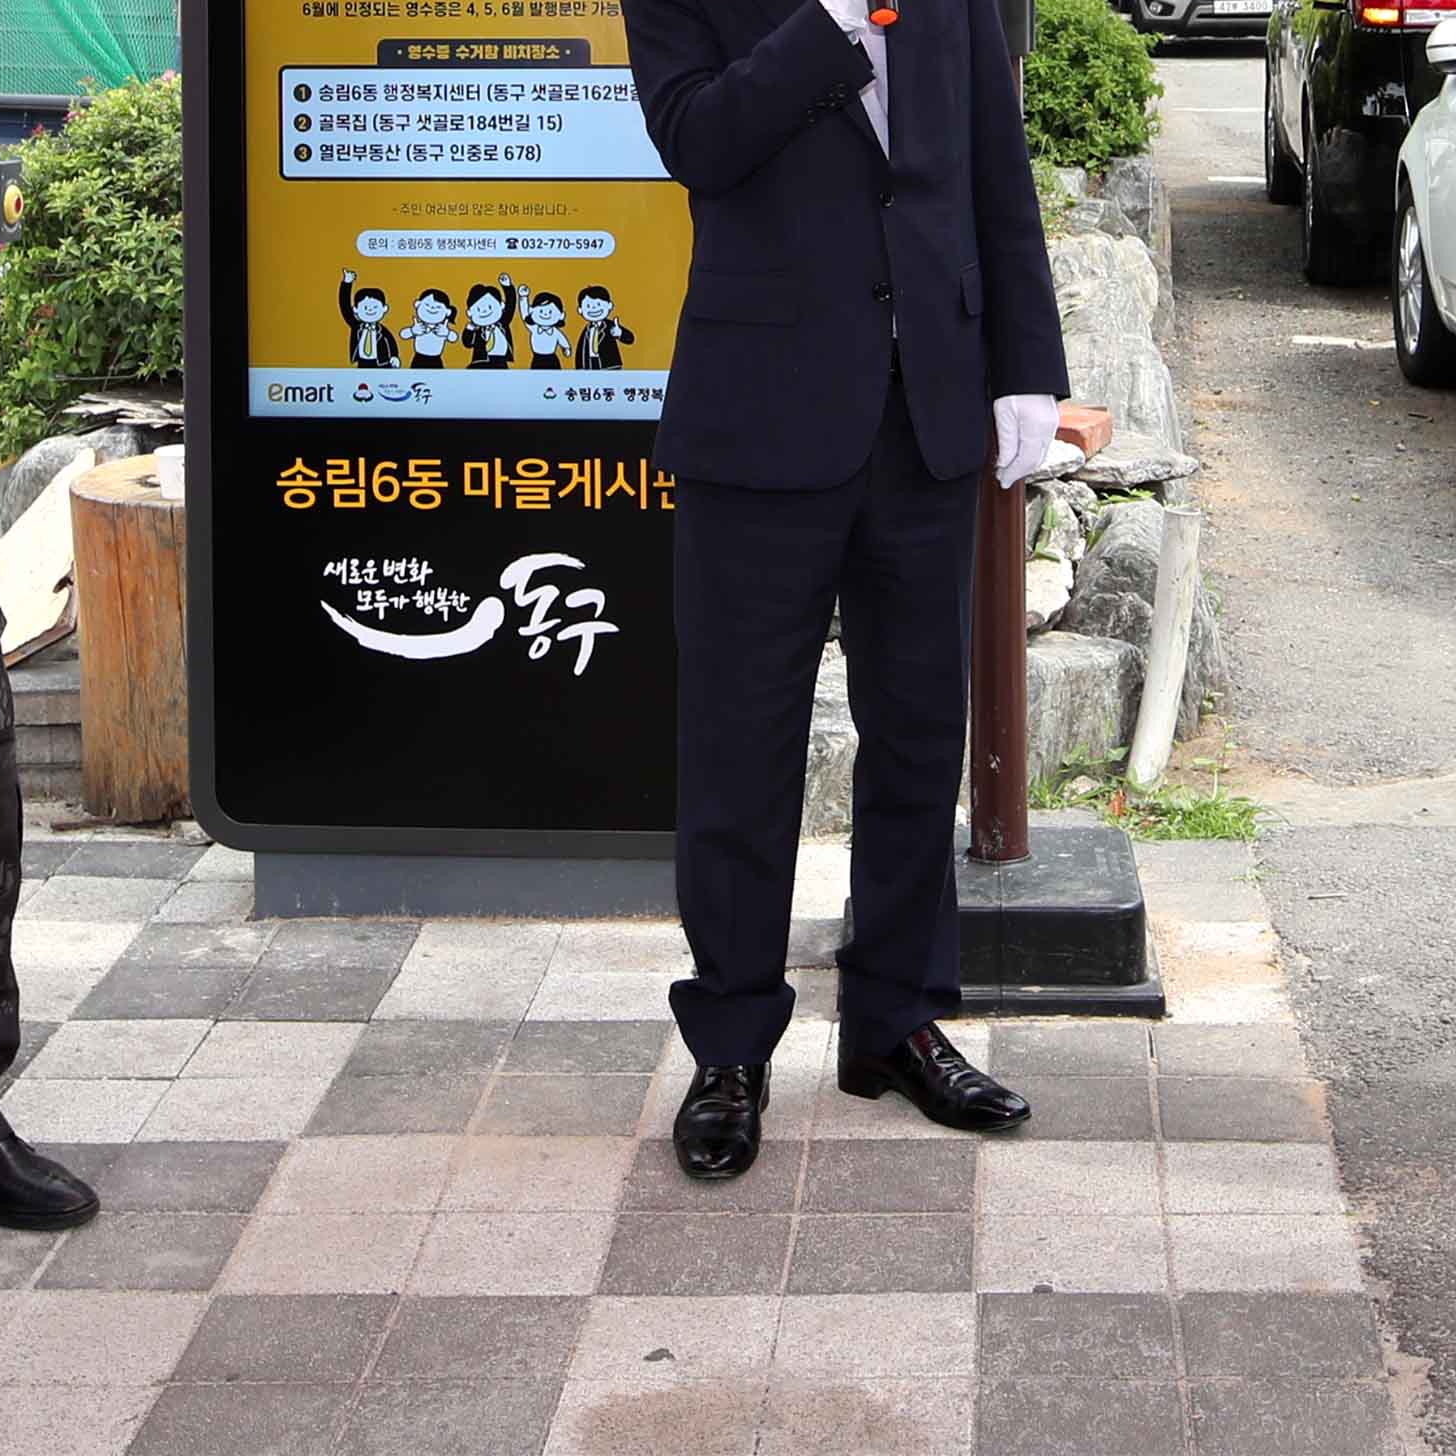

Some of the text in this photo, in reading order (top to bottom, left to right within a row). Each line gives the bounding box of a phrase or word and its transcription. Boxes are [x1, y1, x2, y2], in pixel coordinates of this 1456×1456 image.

[302, 1, 339, 18] 6월에
[344, 1, 401, 18] 인정되는
[405, 1, 461, 18] 영수증은
[466, 2, 481, 19] 4,
[484, 2, 498, 19] 5,
[501, 1, 525, 18] 6월
[529, 1, 586, 18] 발행분만
[407, 44, 561, 60] 영수증 수거함 비치장소
[318, 82, 379, 103] 송림6동
[382, 82, 481, 103] 행정복지센터
[486, 82, 526, 104] (동구
[318, 113, 368, 133] 골목집
[372, 113, 412, 134] (동구
[415, 112, 531, 133] 샛골로184번길
[536, 113, 564, 134] 15)
[318, 142, 401, 163] 열린부동산
[405, 143, 445, 164] (동구
[449, 142, 499, 163] 인중로
[503, 143, 542, 164] 678)
[399, 202, 571, 217] 주민 여러분의 많은 참여 바랍니다.
[367, 237, 605, 250] 문의 송림6동 행정복지센터 032-770-5947
[267, 382, 335, 403] emart
[564, 387, 616, 402] 송림6동
[275, 455, 450, 511] 송림6동
[323, 557, 434, 586] 새로운 변화
[355, 587, 471, 623] 모두가 행복한
[498, 551, 621, 678] 동구
